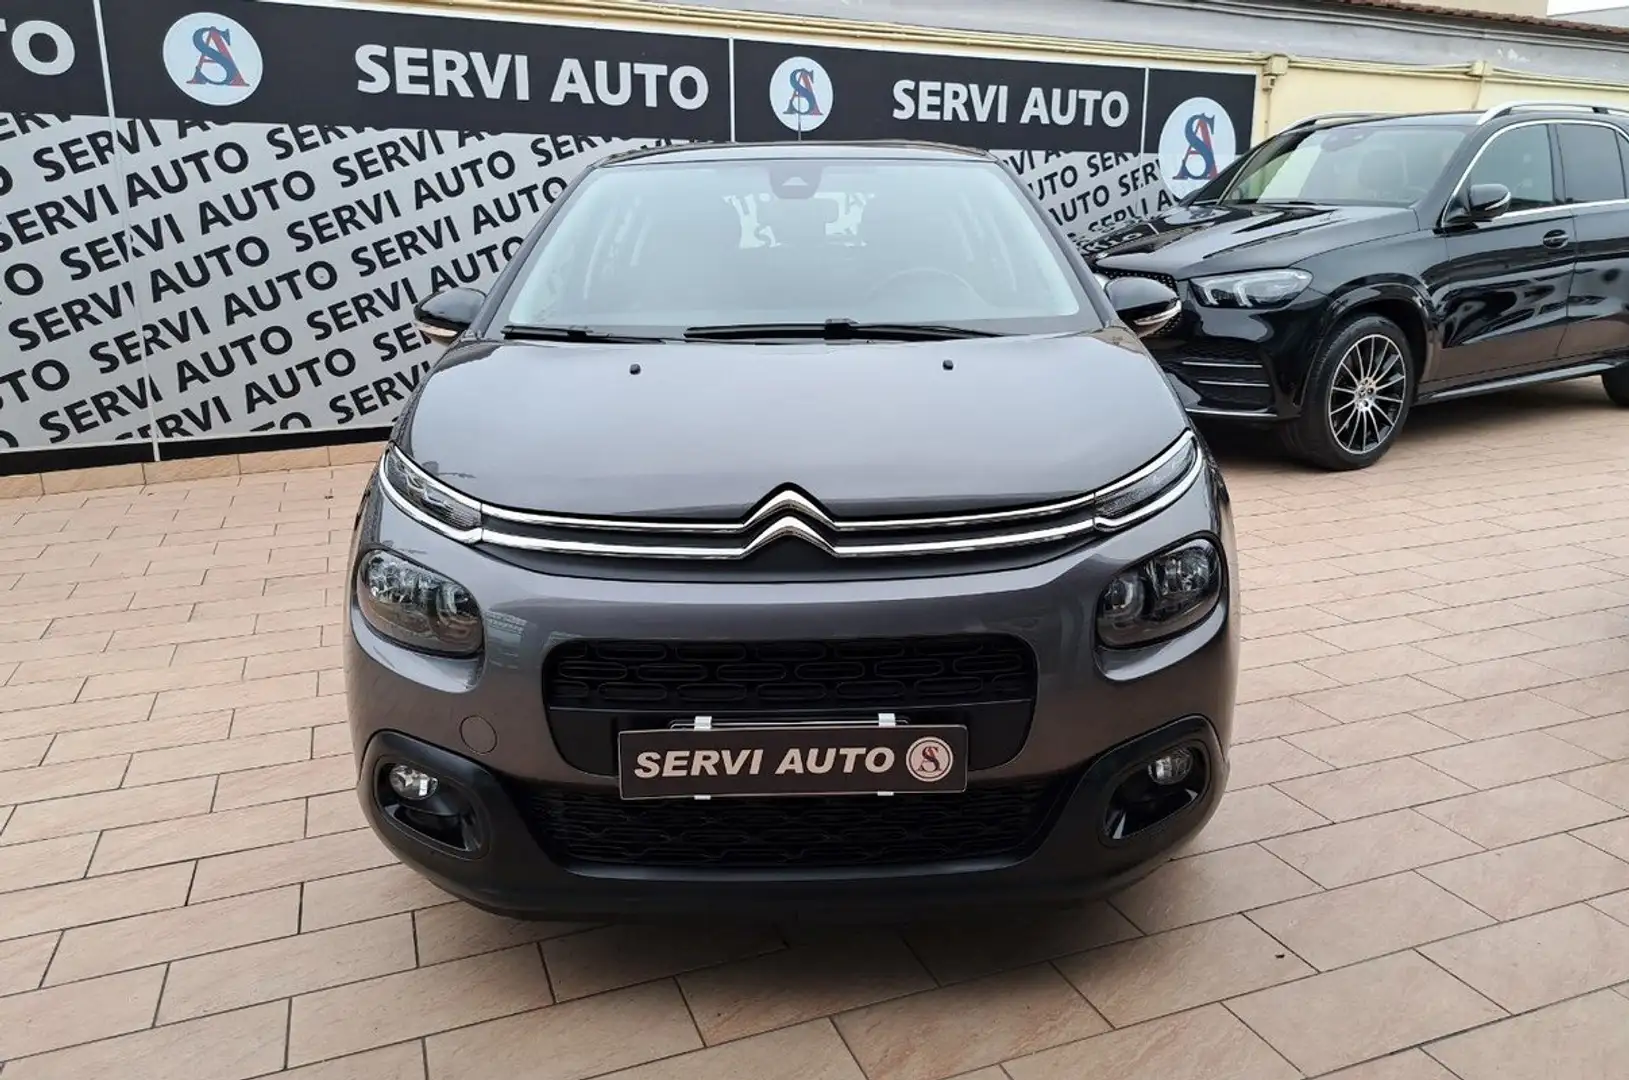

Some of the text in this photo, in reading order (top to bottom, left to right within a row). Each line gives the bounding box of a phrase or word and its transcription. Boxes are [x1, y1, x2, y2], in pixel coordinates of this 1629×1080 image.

[354, 44, 709, 111] SERVI AUTO
[892, 79, 1130, 129] SERVI AUTO
[33, 118, 162, 183] SERVI
[126, 141, 249, 208] AUTO
[60, 212, 186, 281] SERVI
[199, 170, 316, 236] AUTO
[332, 129, 445, 188] SERVI
[150, 235, 270, 303] AUTO
[286, 189, 402, 253] SERVI
[413, 150, 516, 210] AUTO
[89, 305, 211, 374] SERVI
[223, 260, 339, 327] AUTO
[351, 214, 461, 278] SERVI
[473, 176, 568, 236] AUTO
[39, 373, 164, 444] SERVI
[176, 325, 294, 394] AUTO
[306, 276, 418, 341] SERVI
[244, 348, 357, 415] AUTO
[634, 749, 765, 779] SERVI
[774, 746, 896, 776] AUTO
